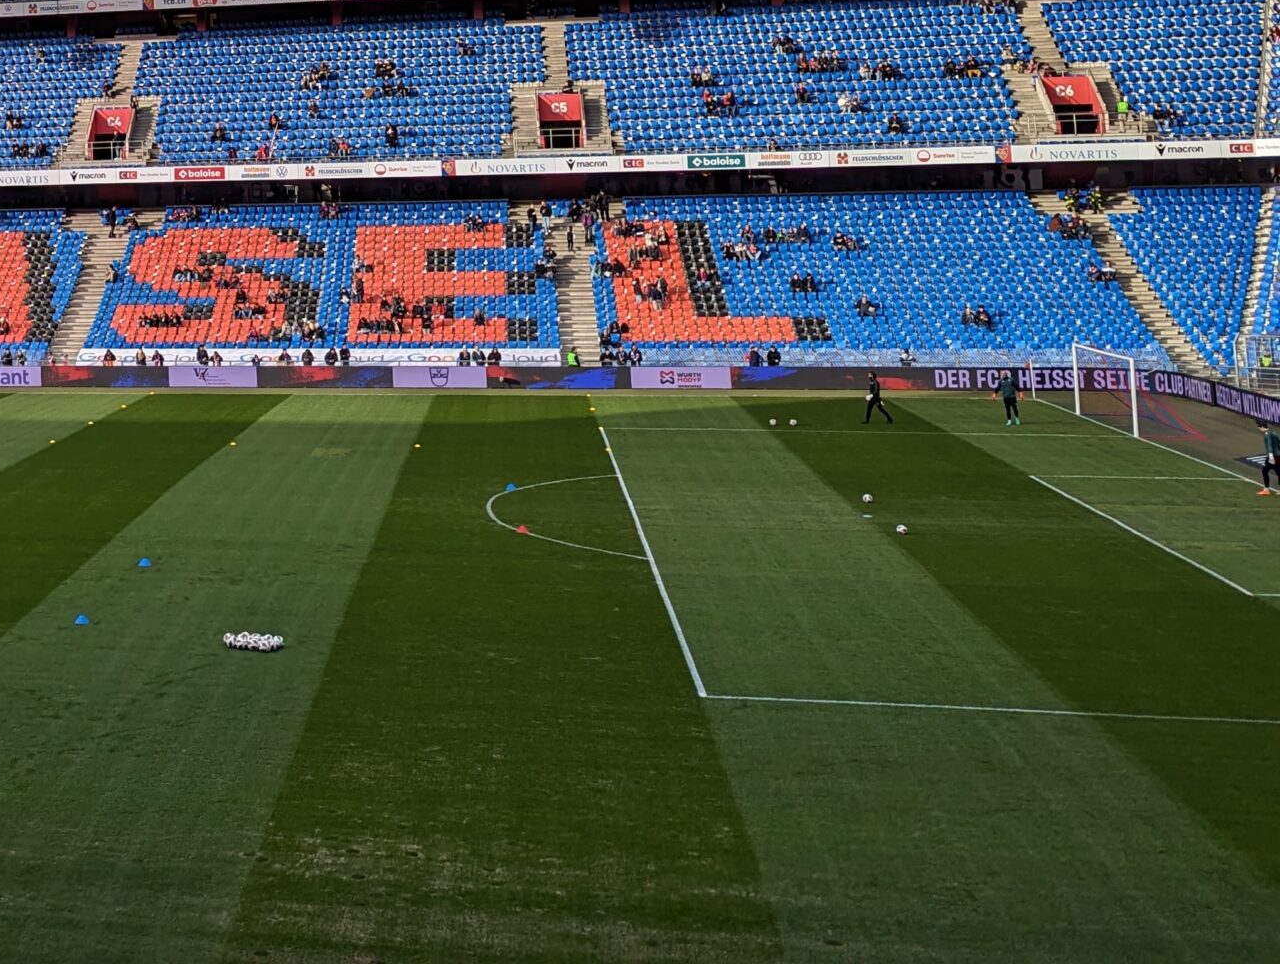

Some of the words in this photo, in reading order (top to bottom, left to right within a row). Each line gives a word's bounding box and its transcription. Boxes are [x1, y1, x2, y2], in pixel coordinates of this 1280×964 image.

[1055, 84, 1075, 97] C6
[550, 101, 568, 113] C5
[106, 116, 122, 127] C4
[1167, 144, 1204, 154] macron
[1231, 144, 1251, 152] CIC
[1049, 149, 1118, 160] NOVARTIS
[576, 159, 608, 168] macron
[624, 159, 643, 167] CIC
[703, 155, 741, 166] baloise
[188, 168, 221, 178] baloise
[487, 162, 546, 173] NOVARTIS
[78, 171, 106, 180] macron
[120, 171, 136, 179] CIC
[934, 369, 970, 388] DER
[1019, 369, 1087, 388] HEISST
[1155, 375, 1184, 395] CLUB
[1184, 377, 1213, 403] PARTNER
[1216, 384, 1242, 413] HERZLICH
